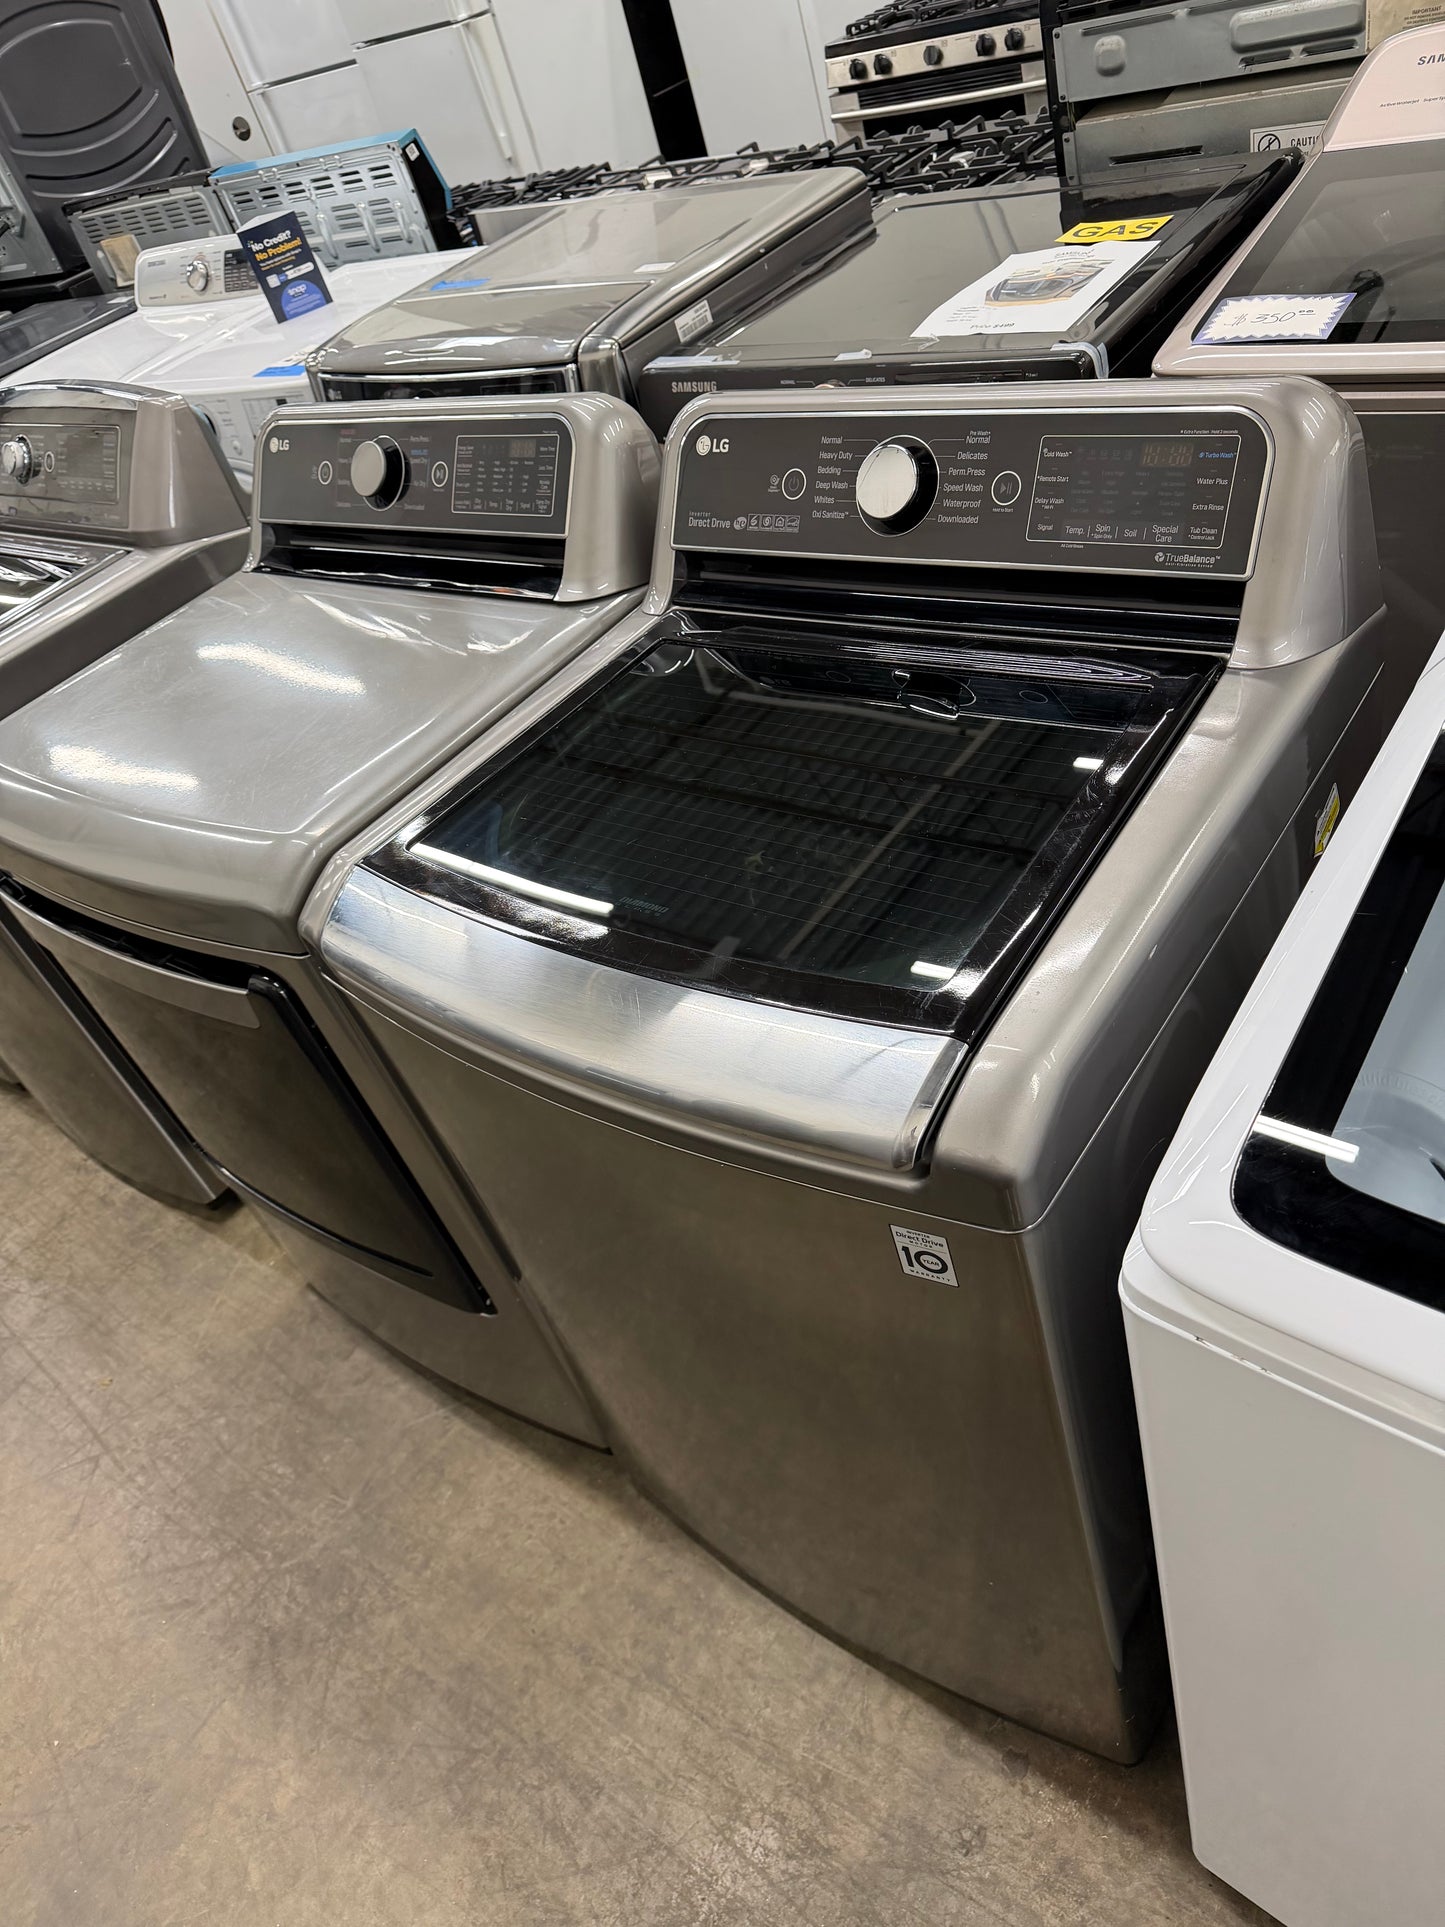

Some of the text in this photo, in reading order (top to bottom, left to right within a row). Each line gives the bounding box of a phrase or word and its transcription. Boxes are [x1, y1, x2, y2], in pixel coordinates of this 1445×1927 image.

[1412, 6, 1442, 15] IMPORTANT
[1073, 222, 1158, 238] GAS
[251, 230, 291, 252] No Credit?
[255, 252, 268, 261] No
[671, 381, 717, 393] SAMSUNG
[821, 436, 843, 444] Normal
[965, 436, 991, 444] Normal
[712, 438, 730, 453] LG
[819, 451, 853, 460] Heavy Duty
[957, 452, 988, 460] Delicates
[817, 466, 841, 476] Bedding
[948, 468, 986, 476] Perm.Press
[815, 481, 848, 491] Deep Wash
[943, 484, 983, 492] Speed Wash
[814, 496, 835, 504] Whites
[943, 499, 981, 509] Waterproof
[688, 517, 710, 528] Direct
[711, 517, 731, 529] Drive
[938, 514, 979, 523] Downloaded
[1037, 523, 1054, 531] Signal
[1065, 525, 1085, 535] Temp.
[1095, 523, 1111, 533] Spin
[1152, 525, 1179, 534] Special
[1124, 529, 1138, 537] Soil
[1155, 534, 1172, 543] Care
[896, 1231, 944, 1248] Direct Drive
[901, 1245, 949, 1275] 10
[922, 1258, 940, 1267] YEAR
[910, 1269, 951, 1282] WARRANTY
